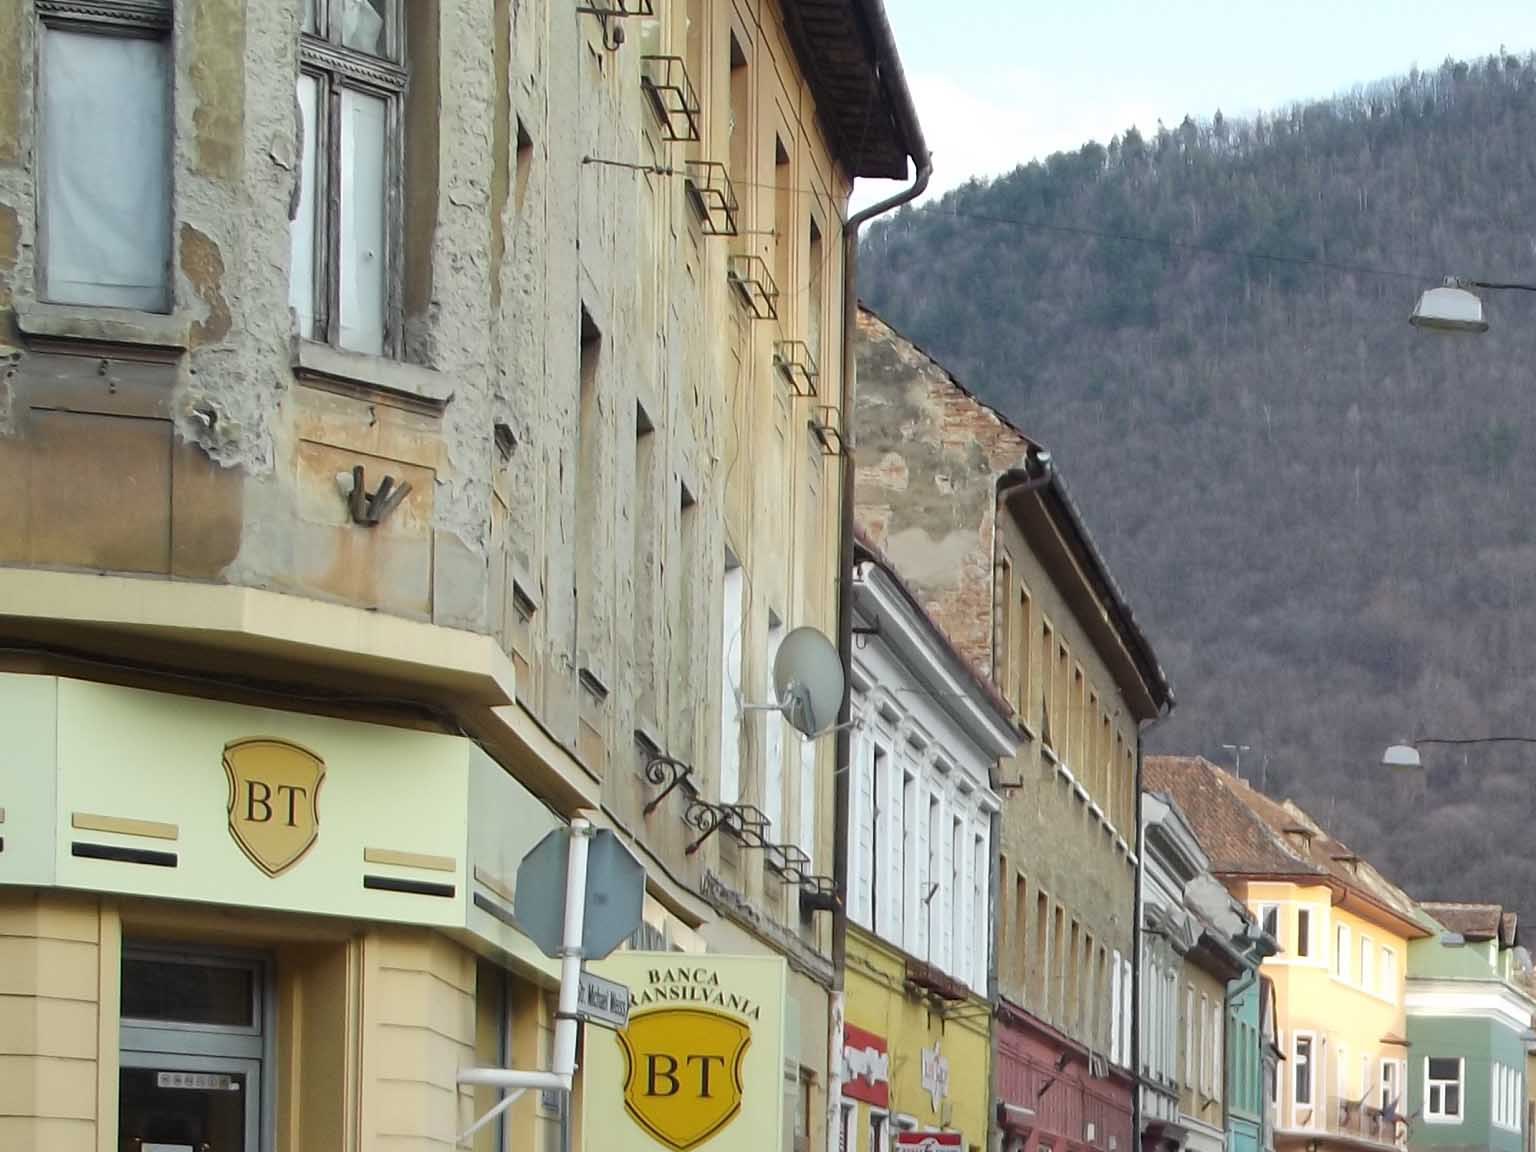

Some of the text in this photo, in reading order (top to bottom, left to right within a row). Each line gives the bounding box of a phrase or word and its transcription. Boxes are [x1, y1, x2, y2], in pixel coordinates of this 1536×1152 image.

[244, 779, 307, 828] BT
[648, 967, 719, 986] BANCA
[630, 986, 761, 1020] RANSILVANIA
[642, 1053, 725, 1099] BT
